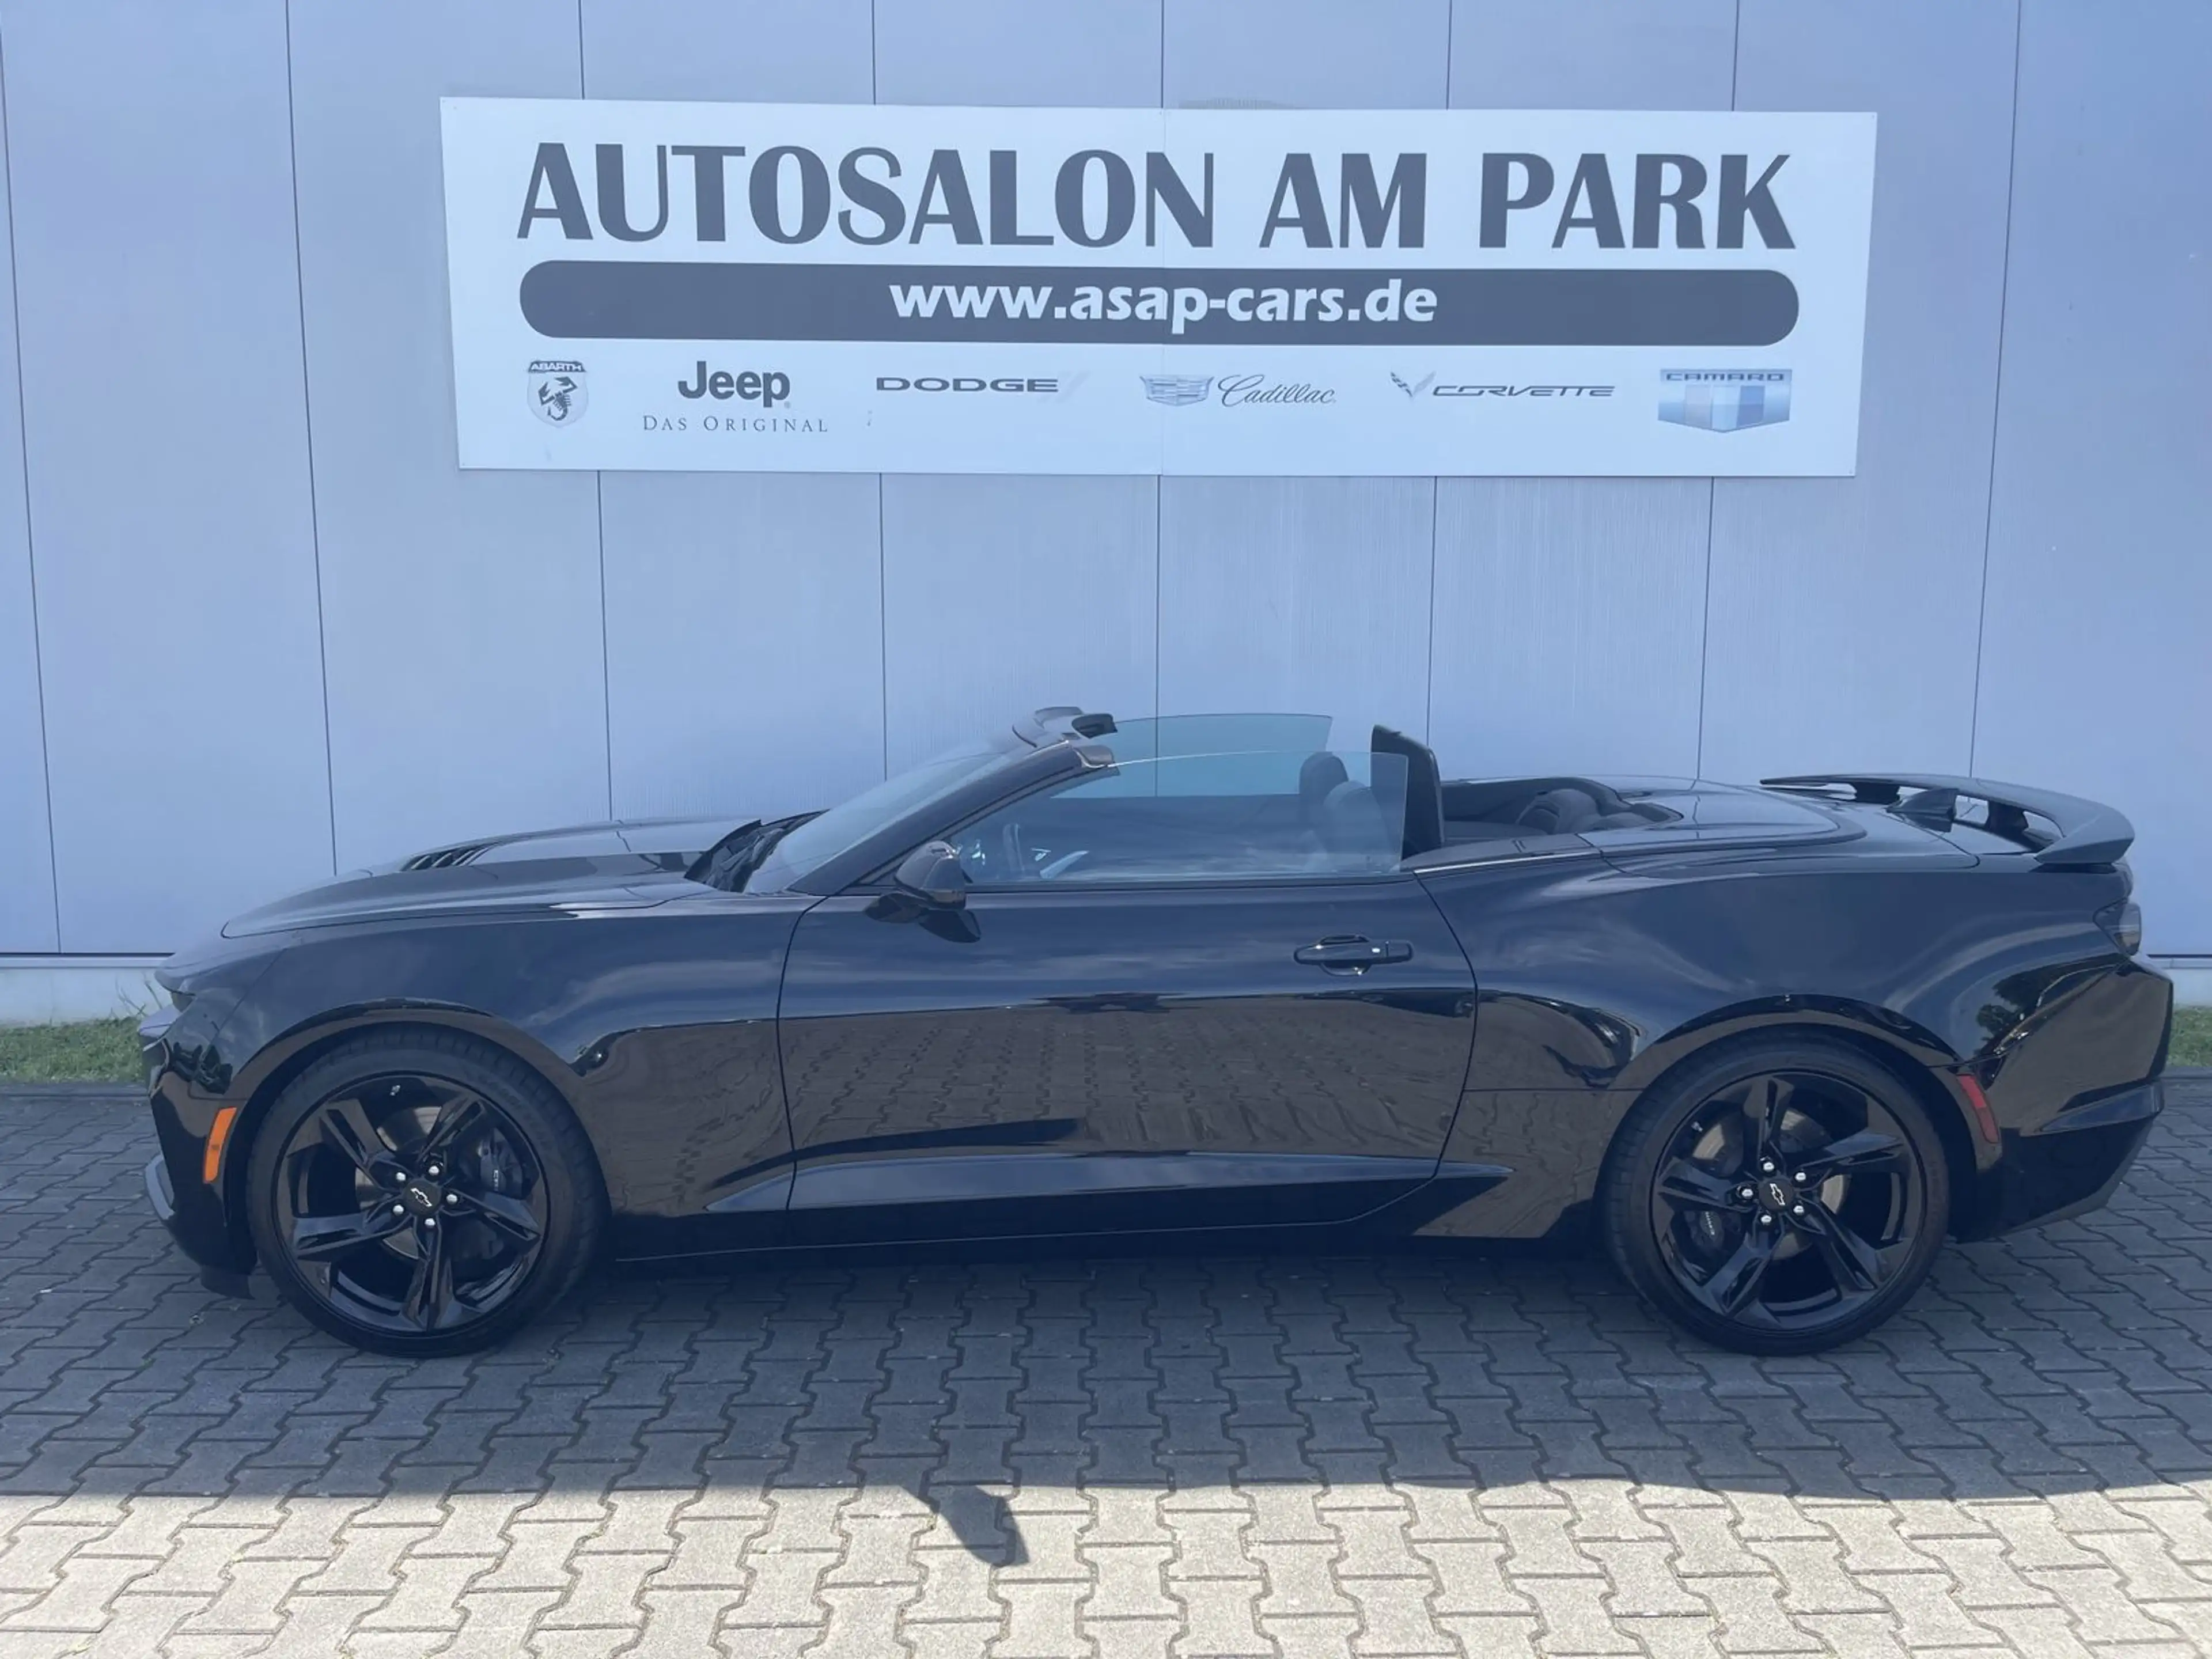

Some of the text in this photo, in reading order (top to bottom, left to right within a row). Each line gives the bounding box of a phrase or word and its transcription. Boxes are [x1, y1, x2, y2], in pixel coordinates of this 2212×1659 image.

[517, 142, 1796, 249] AUTOSALON AM PARK
[888, 278, 1438, 334] www.asap-cars.de
[530, 362, 582, 372] ABARTH
[1665, 373, 1785, 381] CAMARO
[677, 360, 791, 408] Jeep
[876, 377, 1059, 393] DODGE
[1217, 374, 1334, 407] Cadillac
[1432, 385, 1615, 397] CORVETTE
